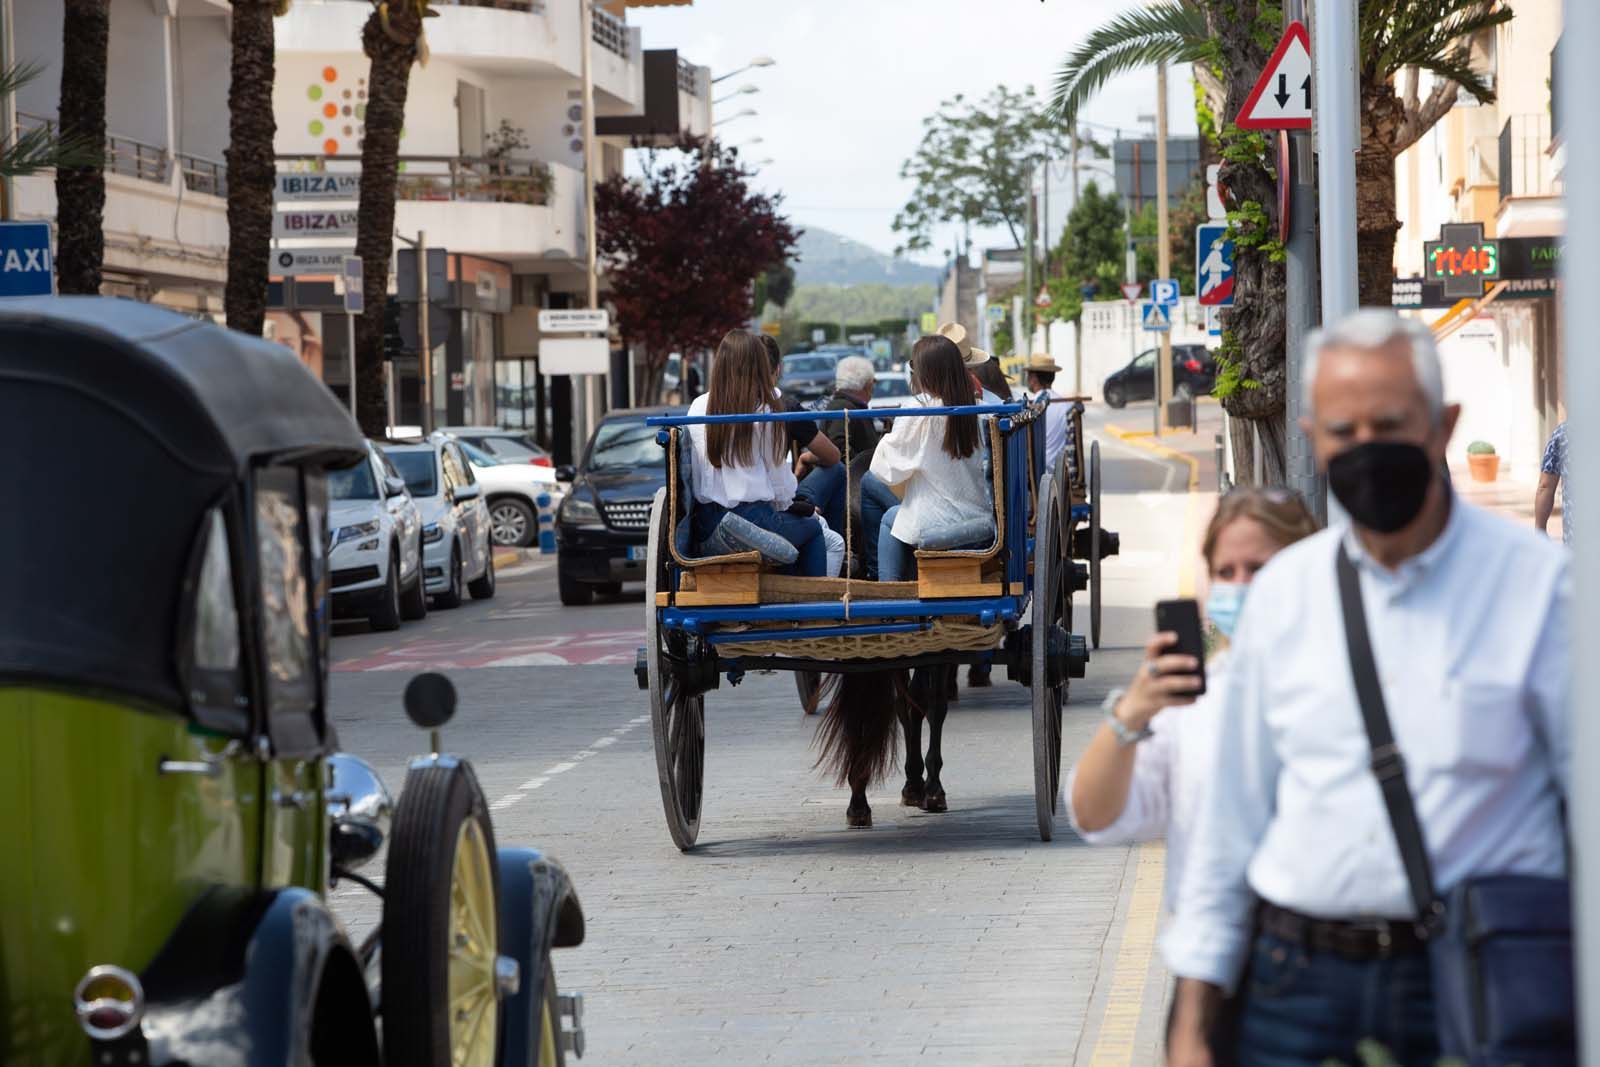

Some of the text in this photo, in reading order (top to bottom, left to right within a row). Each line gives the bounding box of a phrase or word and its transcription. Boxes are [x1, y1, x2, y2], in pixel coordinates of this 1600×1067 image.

[282, 177, 338, 193] IBIZA
[284, 213, 358, 230] IBIZA LIV
[0, 248, 50, 272] AXI
[1156, 283, 1174, 304] P
